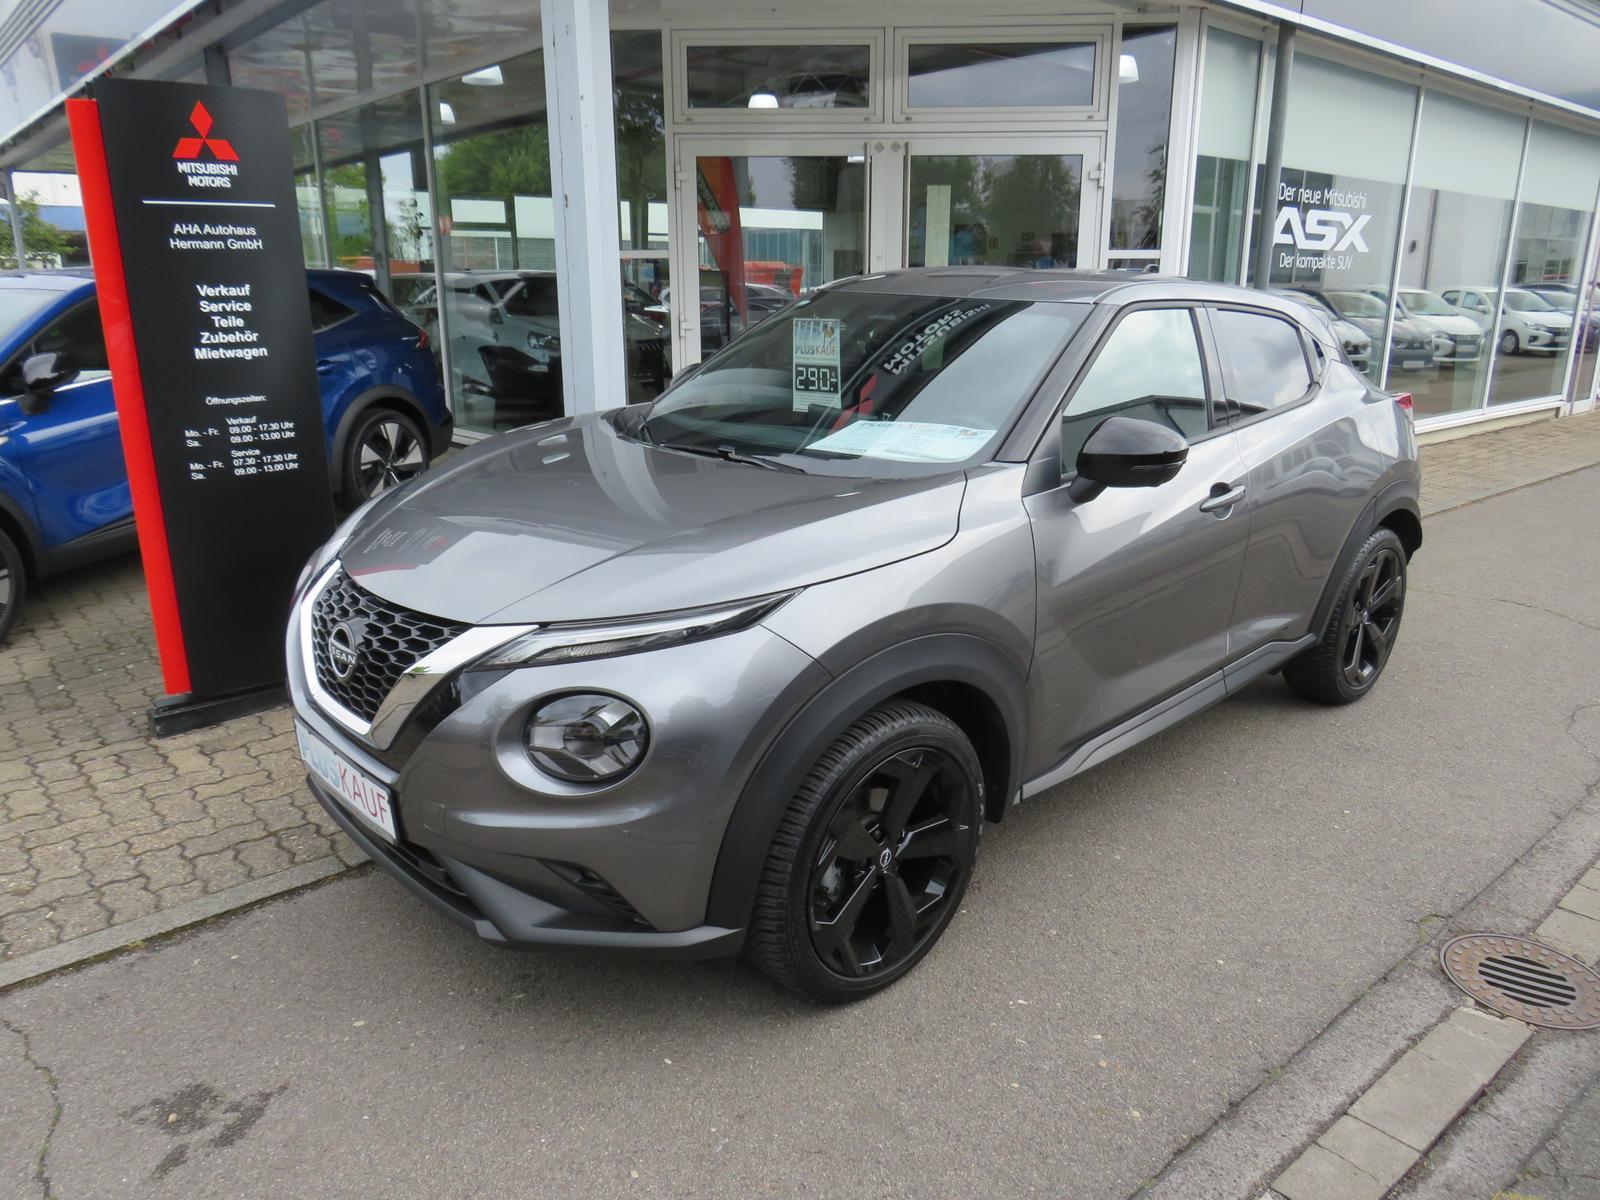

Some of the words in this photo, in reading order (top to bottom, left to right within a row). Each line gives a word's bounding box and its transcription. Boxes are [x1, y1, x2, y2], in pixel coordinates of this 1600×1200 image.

[177, 162, 238, 176] MITSUBISHI
[187, 175, 231, 188] MOTORS
[1278, 182, 1295, 201] Der
[1298, 188, 1321, 204] neue
[1323, 188, 1368, 209] Mitsubishi
[173, 223, 201, 235] AHA
[203, 224, 257, 236] Autohaus
[1272, 206, 1373, 253] ASX
[170, 238, 224, 250] Hermann
[227, 238, 263, 250] GmbH
[1279, 252, 1294, 268] Der
[1295, 252, 1335, 272] kompakte
[1337, 255, 1353, 270] SUV
[196, 284, 251, 297] Verkauf
[199, 300, 252, 313] Service
[211, 316, 244, 328] Teile
[200, 331, 258, 344] Zubehör
[194, 346, 268, 360] Mietwagen
[225, 416, 257, 425] Verkauf
[184, 430, 202, 438] Mo.
[208, 428, 220, 436] Fr.
[259, 422, 279, 431] 17.30
[280, 421, 294, 429] Uhr
[281, 431, 296, 439] Uhr
[231, 449, 261, 458] Service
[189, 462, 206, 471] Mo.
[262, 455, 282, 463] 17.30
[284, 453, 298, 461] Uhr
[191, 472, 207, 480] Sa.
[285, 462, 299, 470] Uhr
